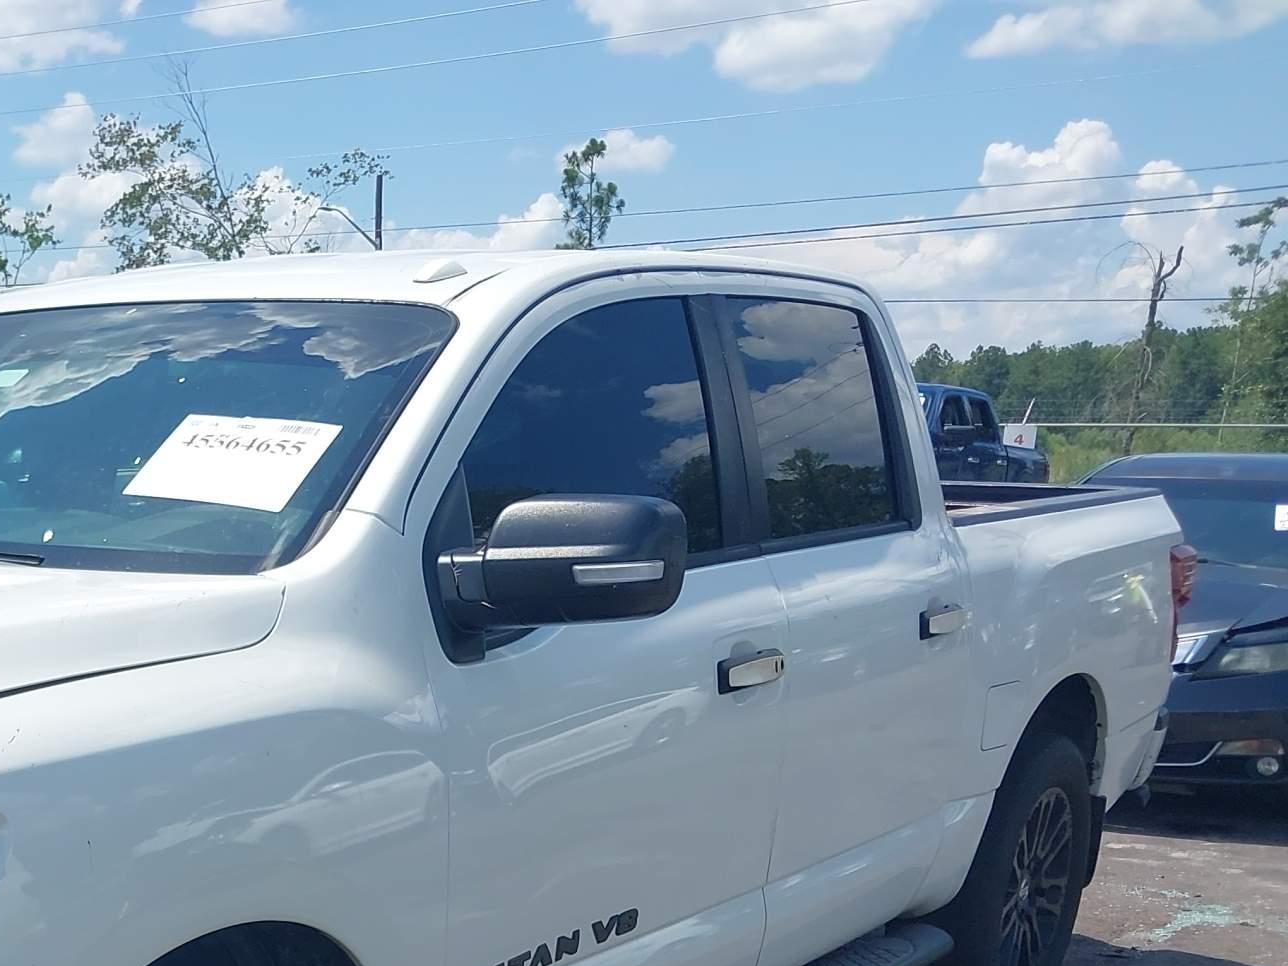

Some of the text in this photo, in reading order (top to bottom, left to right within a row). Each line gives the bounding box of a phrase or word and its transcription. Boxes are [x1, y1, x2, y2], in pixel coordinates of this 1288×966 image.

[182, 433, 307, 456] 45564655
[1014, 434, 1024, 446] 4
[591, 908, 639, 944] V8
